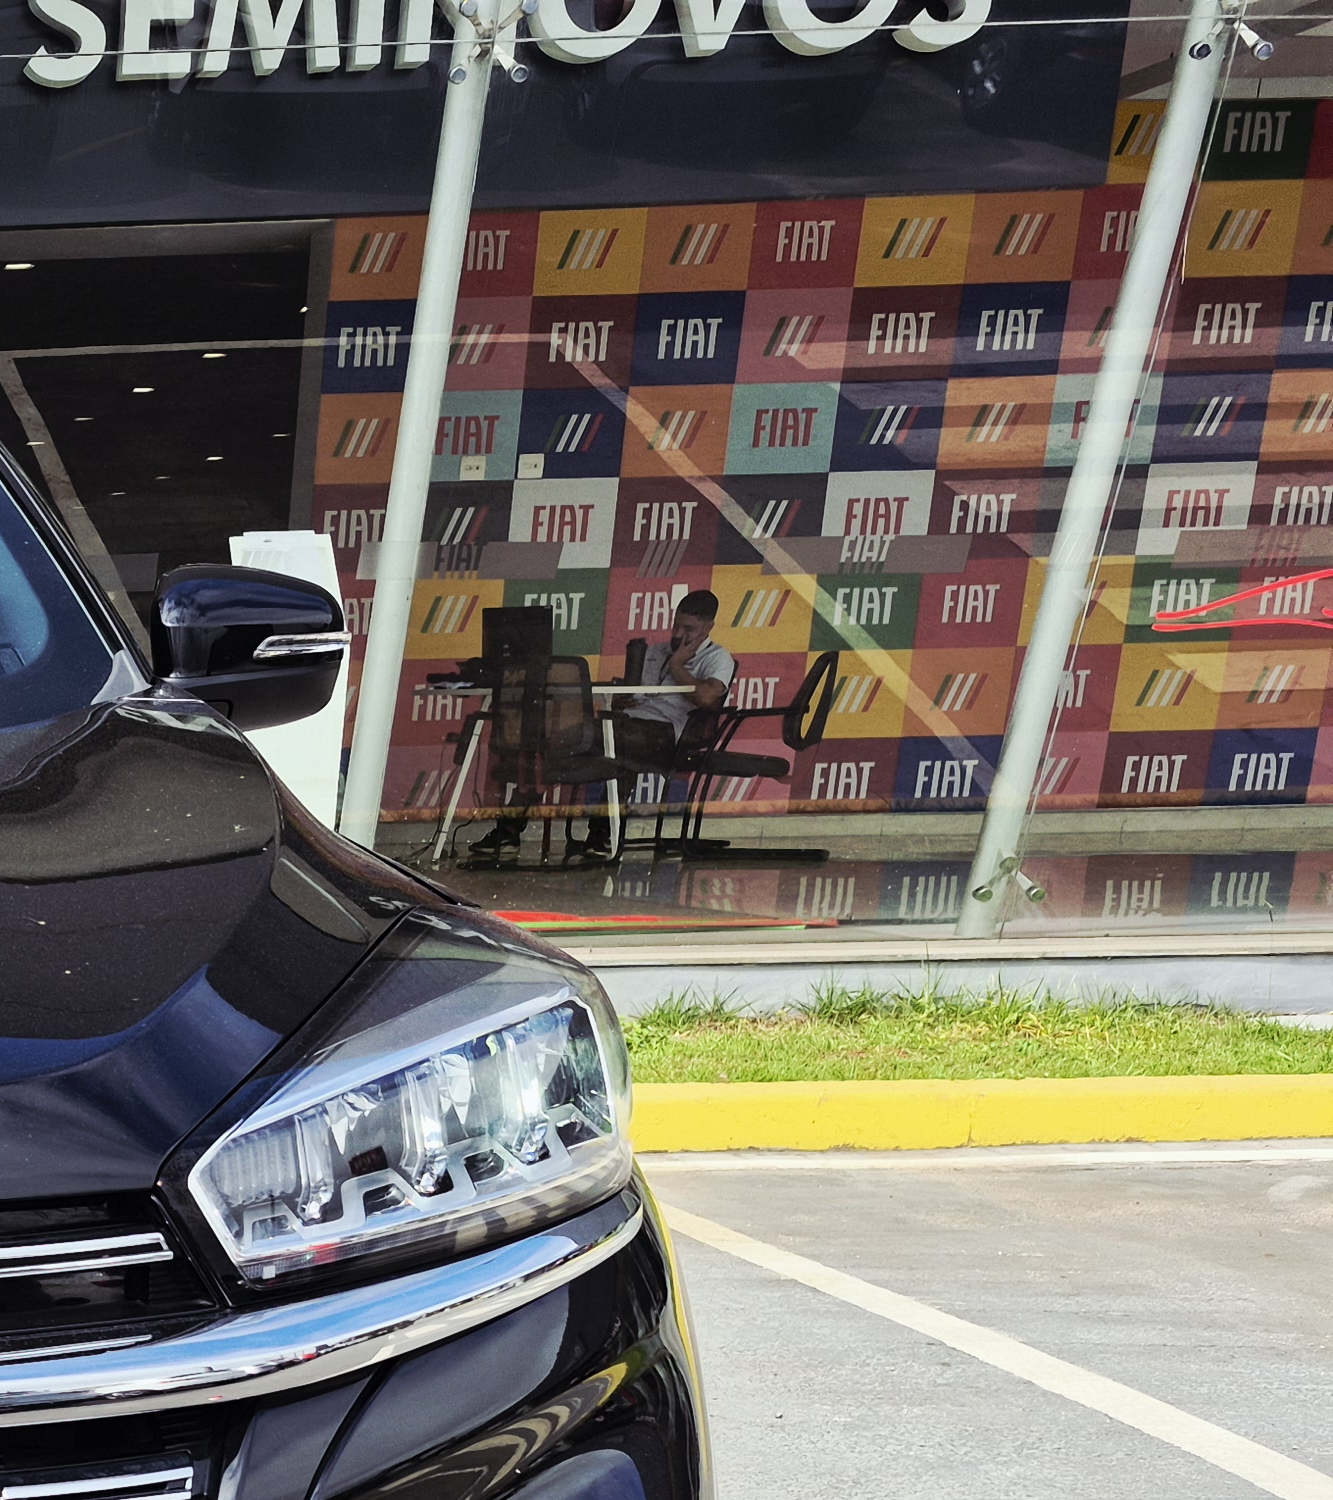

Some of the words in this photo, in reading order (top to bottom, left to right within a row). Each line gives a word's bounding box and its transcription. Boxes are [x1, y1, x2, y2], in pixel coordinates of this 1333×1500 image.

[1224, 111, 1291, 153] FIAT
[466, 229, 511, 272] IAT
[775, 220, 836, 263] FIAT
[549, 320, 614, 363] FIAT
[657, 317, 723, 360] FIAT
[867, 311, 936, 354] FIAT
[976, 308, 1044, 351] FIAT
[1192, 302, 1262, 345] FIAT
[337, 326, 402, 368] FIAT
[434, 415, 500, 455] FIAT
[751, 406, 819, 448] FIAT
[323, 508, 386, 548] FIAT
[532, 504, 595, 543] FIAT
[633, 501, 698, 541] FIAT
[844, 496, 910, 535] FIAT
[949, 493, 1016, 533] FIAT
[1162, 488, 1231, 529] FIAT
[627, 592, 673, 630] FIA
[833, 586, 898, 626] FIAT
[941, 584, 1000, 623] FIAT
[1149, 578, 1216, 617] FIAT
[1258, 575, 1319, 616] FIAT
[810, 762, 876, 800] FIAT
[914, 759, 979, 798] FIAT
[1120, 754, 1188, 793] FIAT
[1228, 752, 1295, 791] FIAT
